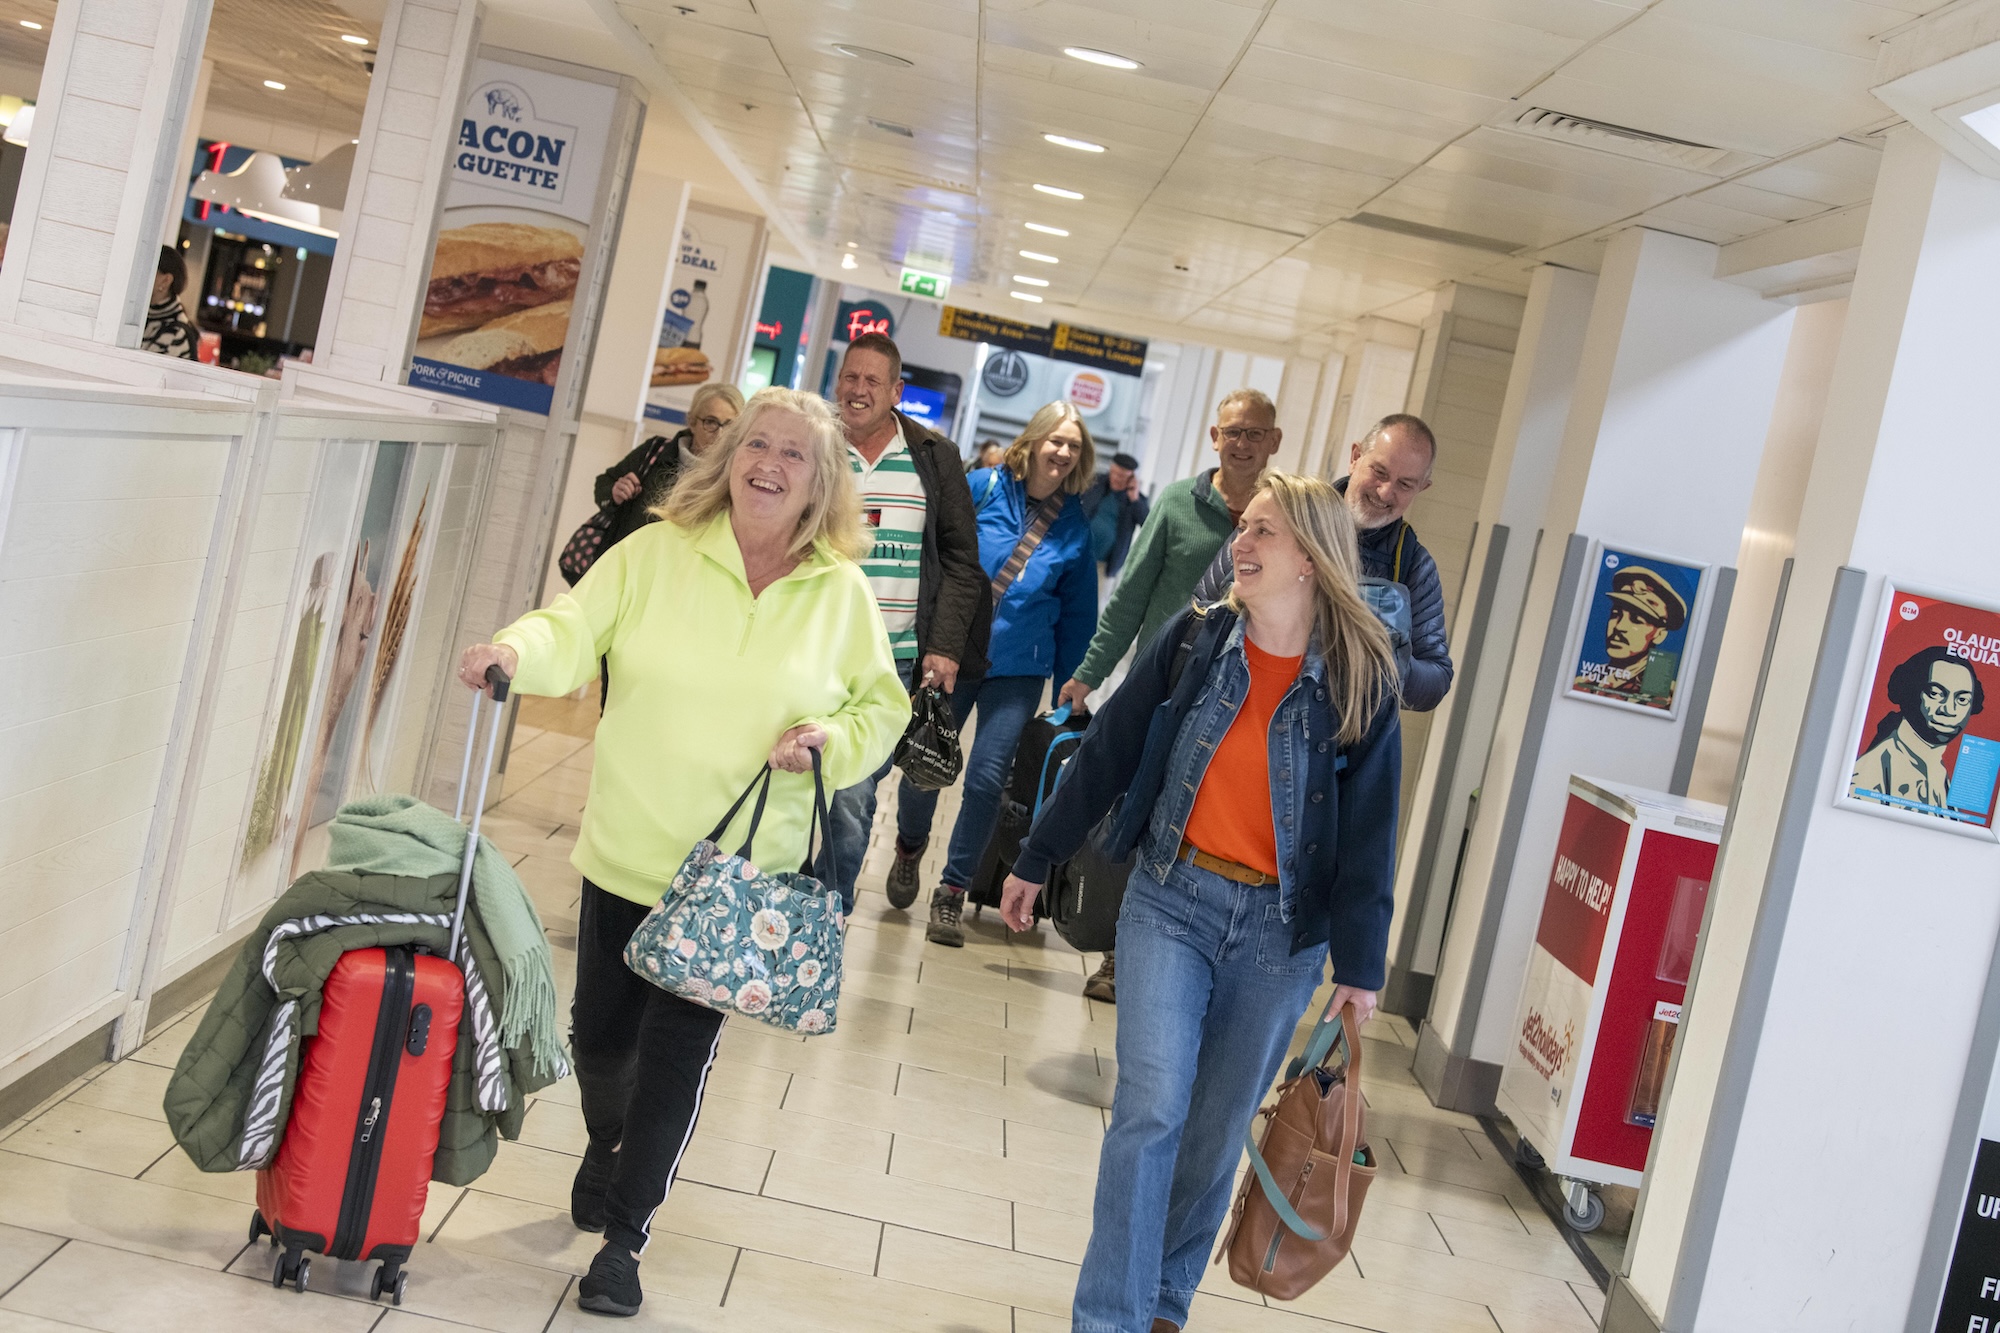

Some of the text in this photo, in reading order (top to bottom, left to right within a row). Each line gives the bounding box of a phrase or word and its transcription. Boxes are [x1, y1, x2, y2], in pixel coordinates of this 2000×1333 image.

[458, 119, 566, 166] ACON
[453, 153, 559, 190] GUETTE
[682, 254, 717, 271] DEAL
[411, 363, 437, 377] PORK
[447, 371, 481, 388] PICKLE
[874, 543, 910, 567] my
[1943, 627, 2000, 652] OLAUD
[1946, 641, 2000, 667] EQUIA
[1580, 669, 1610, 685] TULL
[1582, 660, 1632, 680] WALTER
[1554, 854, 1612, 916] HAPPY TO HELP!
